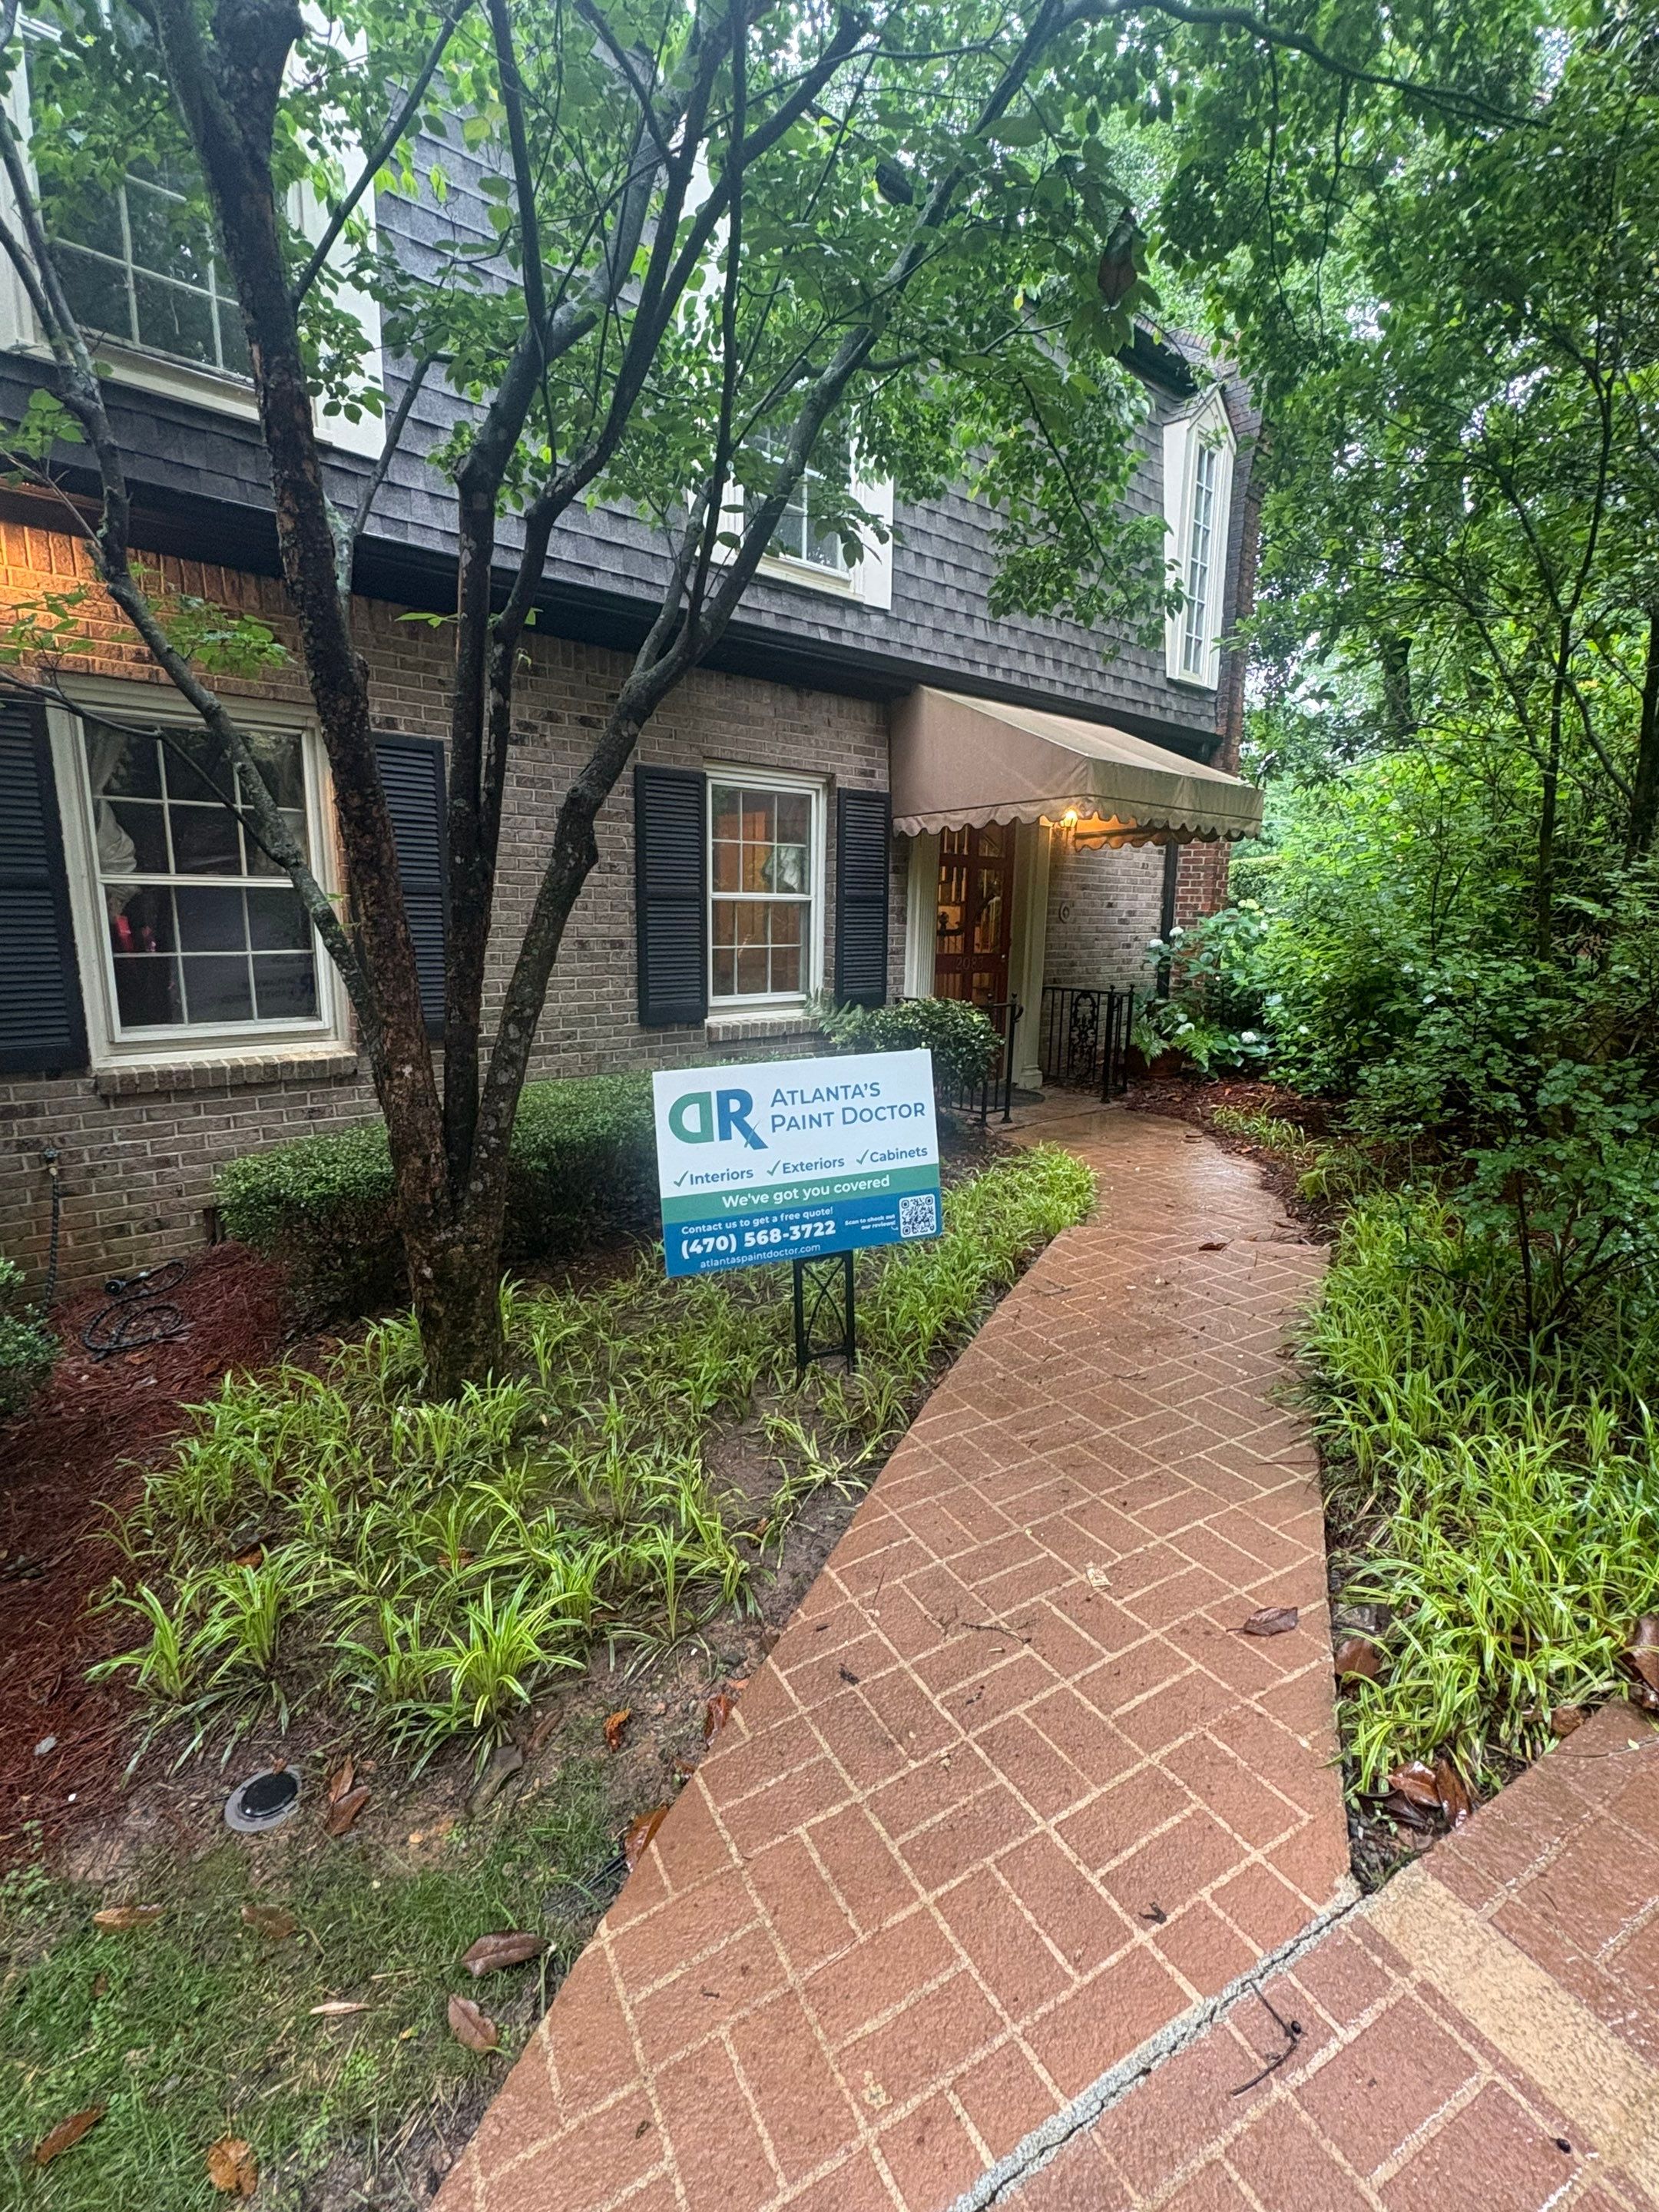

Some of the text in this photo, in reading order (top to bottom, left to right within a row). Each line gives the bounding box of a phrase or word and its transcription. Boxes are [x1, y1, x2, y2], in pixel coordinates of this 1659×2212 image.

[770, 1081, 881, 1108] ATLANTA'S
[770, 1102, 926, 1133] PAINT DOCTOR
[690, 1146, 929, 1186] Interiors Exteriors Cabinets
[722, 1174, 890, 1208] We've got you covered
[681, 1221, 724, 1235] Contact
[725, 1220, 737, 1229] us
[740, 1218, 750, 1227] to
[753, 1217, 770, 1227] get
[780, 1211, 800, 1222] free
[803, 1207, 833, 1219] quote!
[681, 1220, 836, 1260] (470) 568-3722
[700, 1243, 821, 1269] atlantaspaintdoctor.com
